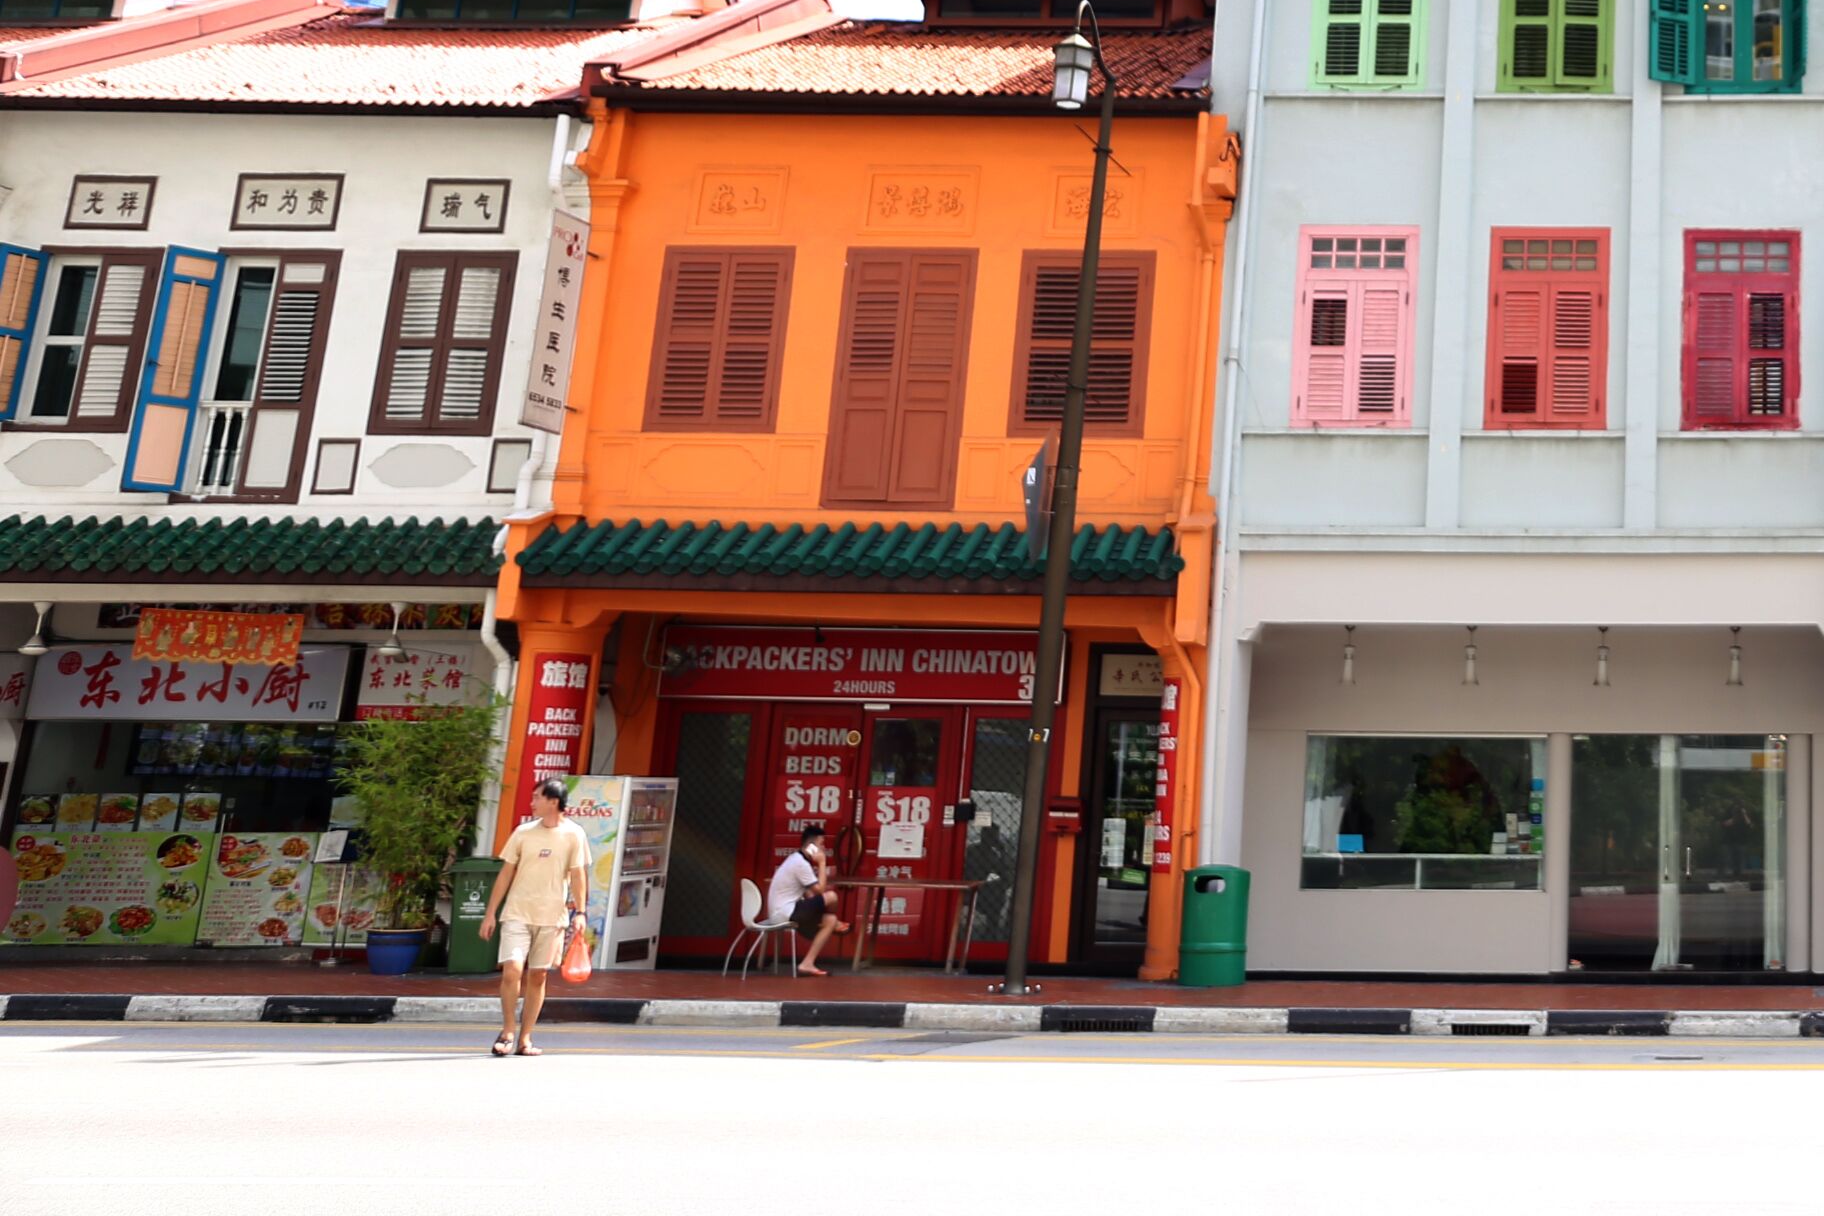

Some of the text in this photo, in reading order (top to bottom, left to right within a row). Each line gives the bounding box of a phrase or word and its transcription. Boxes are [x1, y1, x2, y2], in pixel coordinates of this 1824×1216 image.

[246, 187, 329, 215] 和为贵
[684, 645, 1036, 675] ACKPACKERS' INN CHINATOW
[0, 671, 26, 707] 厨
[79, 650, 311, 713] 东北小厨
[832, 680, 896, 695] 24HOURS
[545, 707, 577, 722] BACK
[545, 739, 568, 752] INN
[785, 727, 848, 746] DORM
[533, 754, 571, 768] CHINA
[785, 755, 841, 775] BEDS
[785, 784, 841, 814] $18
[875, 794, 931, 825] $18
